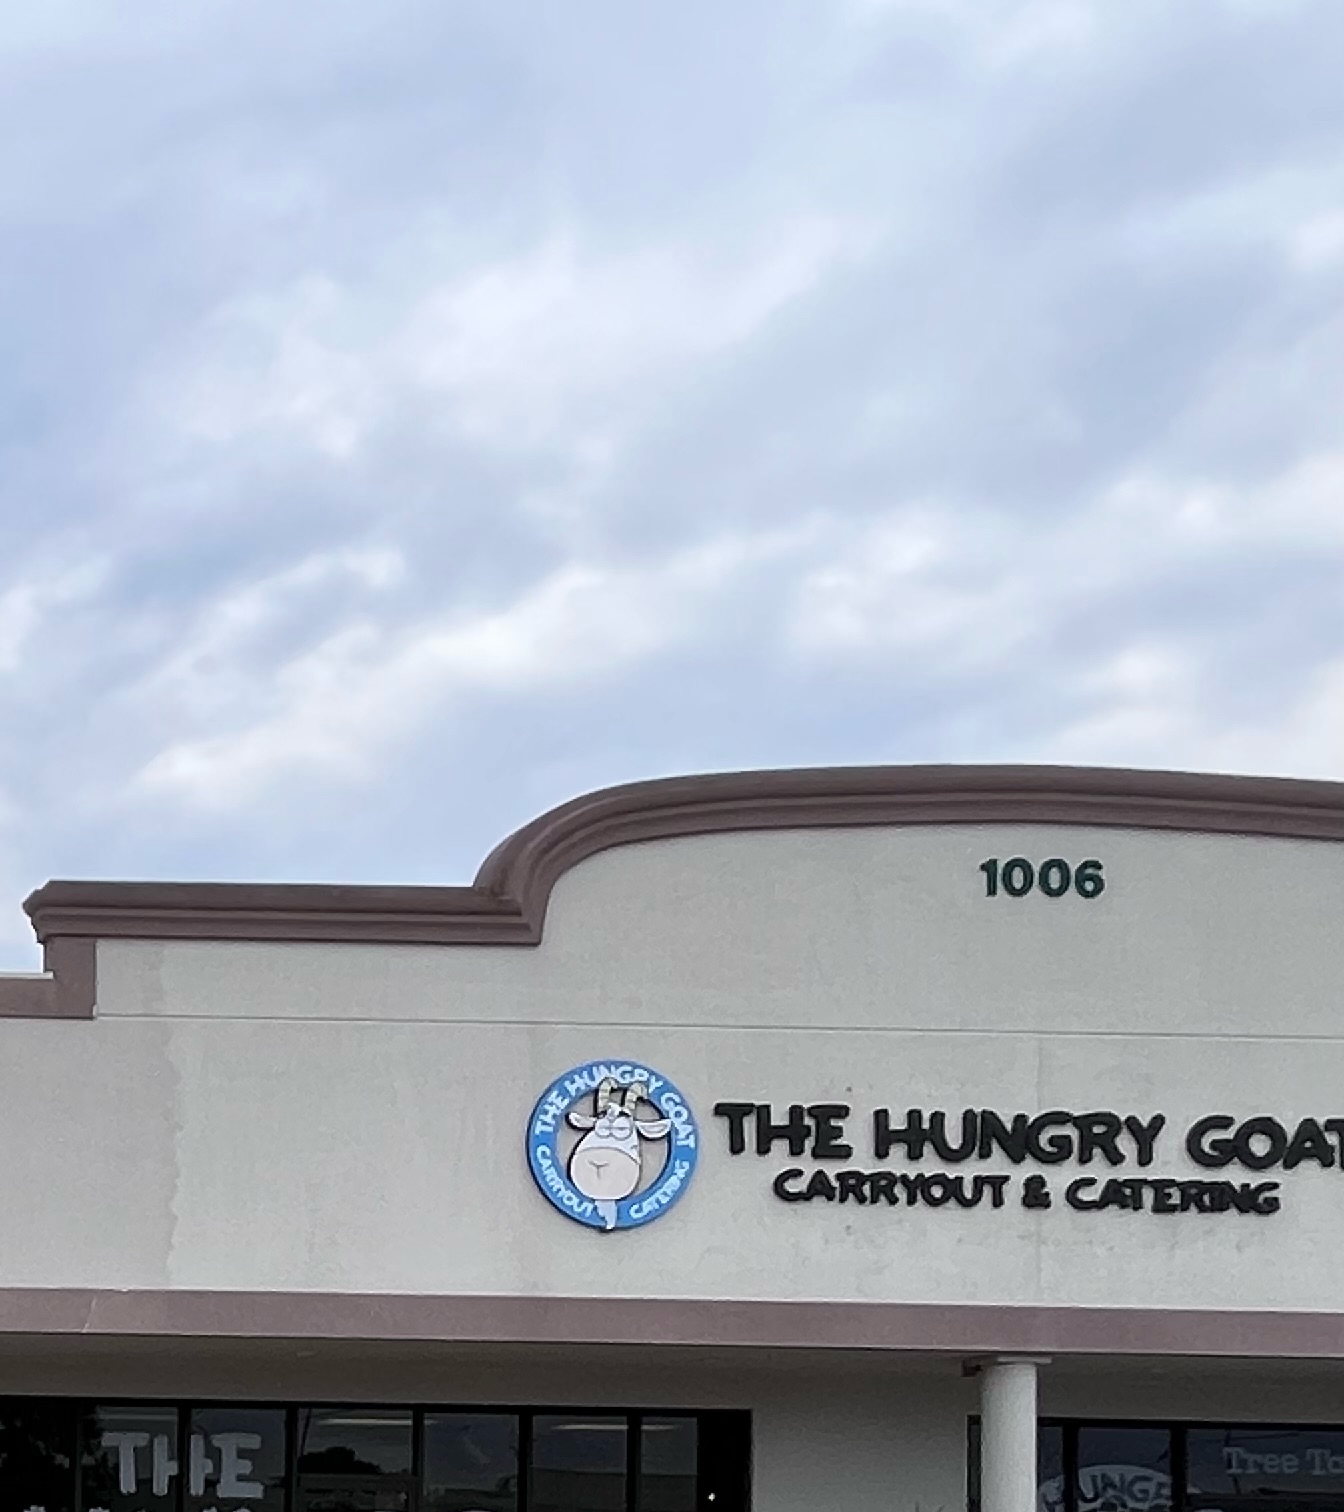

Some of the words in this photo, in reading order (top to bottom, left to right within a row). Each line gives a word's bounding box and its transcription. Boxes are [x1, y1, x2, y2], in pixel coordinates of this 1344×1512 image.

[979, 856, 1105, 899] 1006
[535, 1091, 569, 1136] THE
[565, 1065, 663, 1096] HUNGRY
[661, 1093, 696, 1149] GOAT
[714, 1102, 853, 1160] THE
[874, 1107, 1166, 1167] HUNGRY
[773, 1168, 1012, 1208] CARRYOUT
[1022, 1175, 1052, 1209] &
[1065, 1178, 1281, 1215] CATERING
[101, 1432, 265, 1500] THE
[1223, 1446, 1299, 1474] Tree
